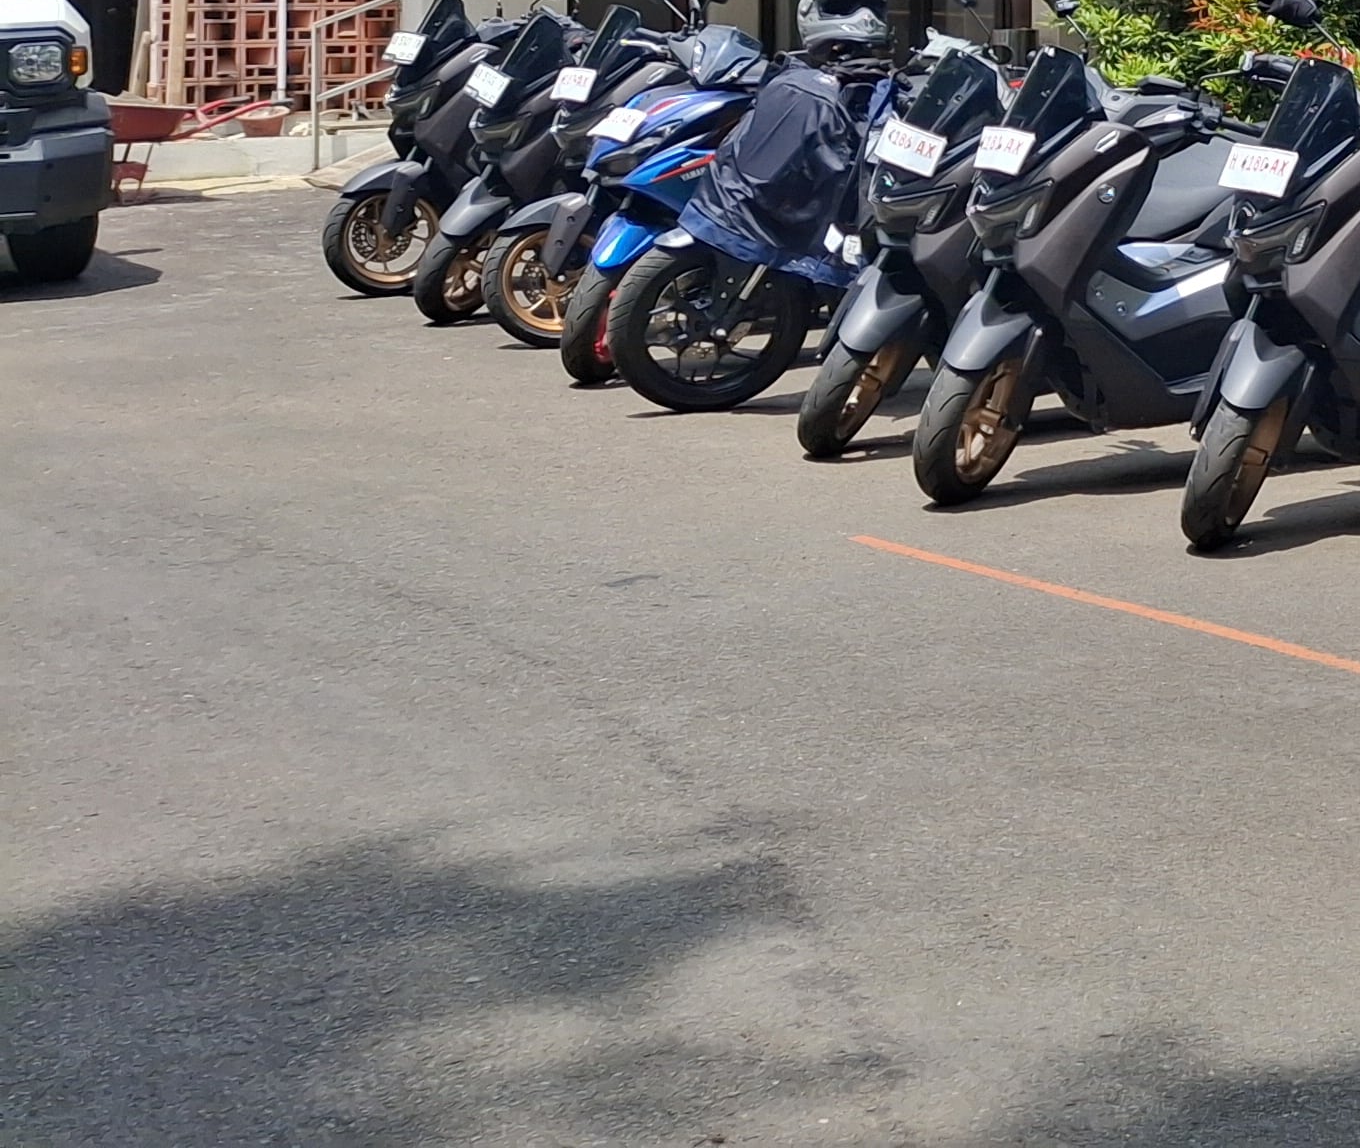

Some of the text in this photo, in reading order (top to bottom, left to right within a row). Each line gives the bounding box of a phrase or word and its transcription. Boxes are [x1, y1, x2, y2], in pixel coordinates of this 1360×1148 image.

[915, 140, 936, 159] AX
[1228, 152, 1238, 170] H
[1270, 158, 1290, 177] AX
